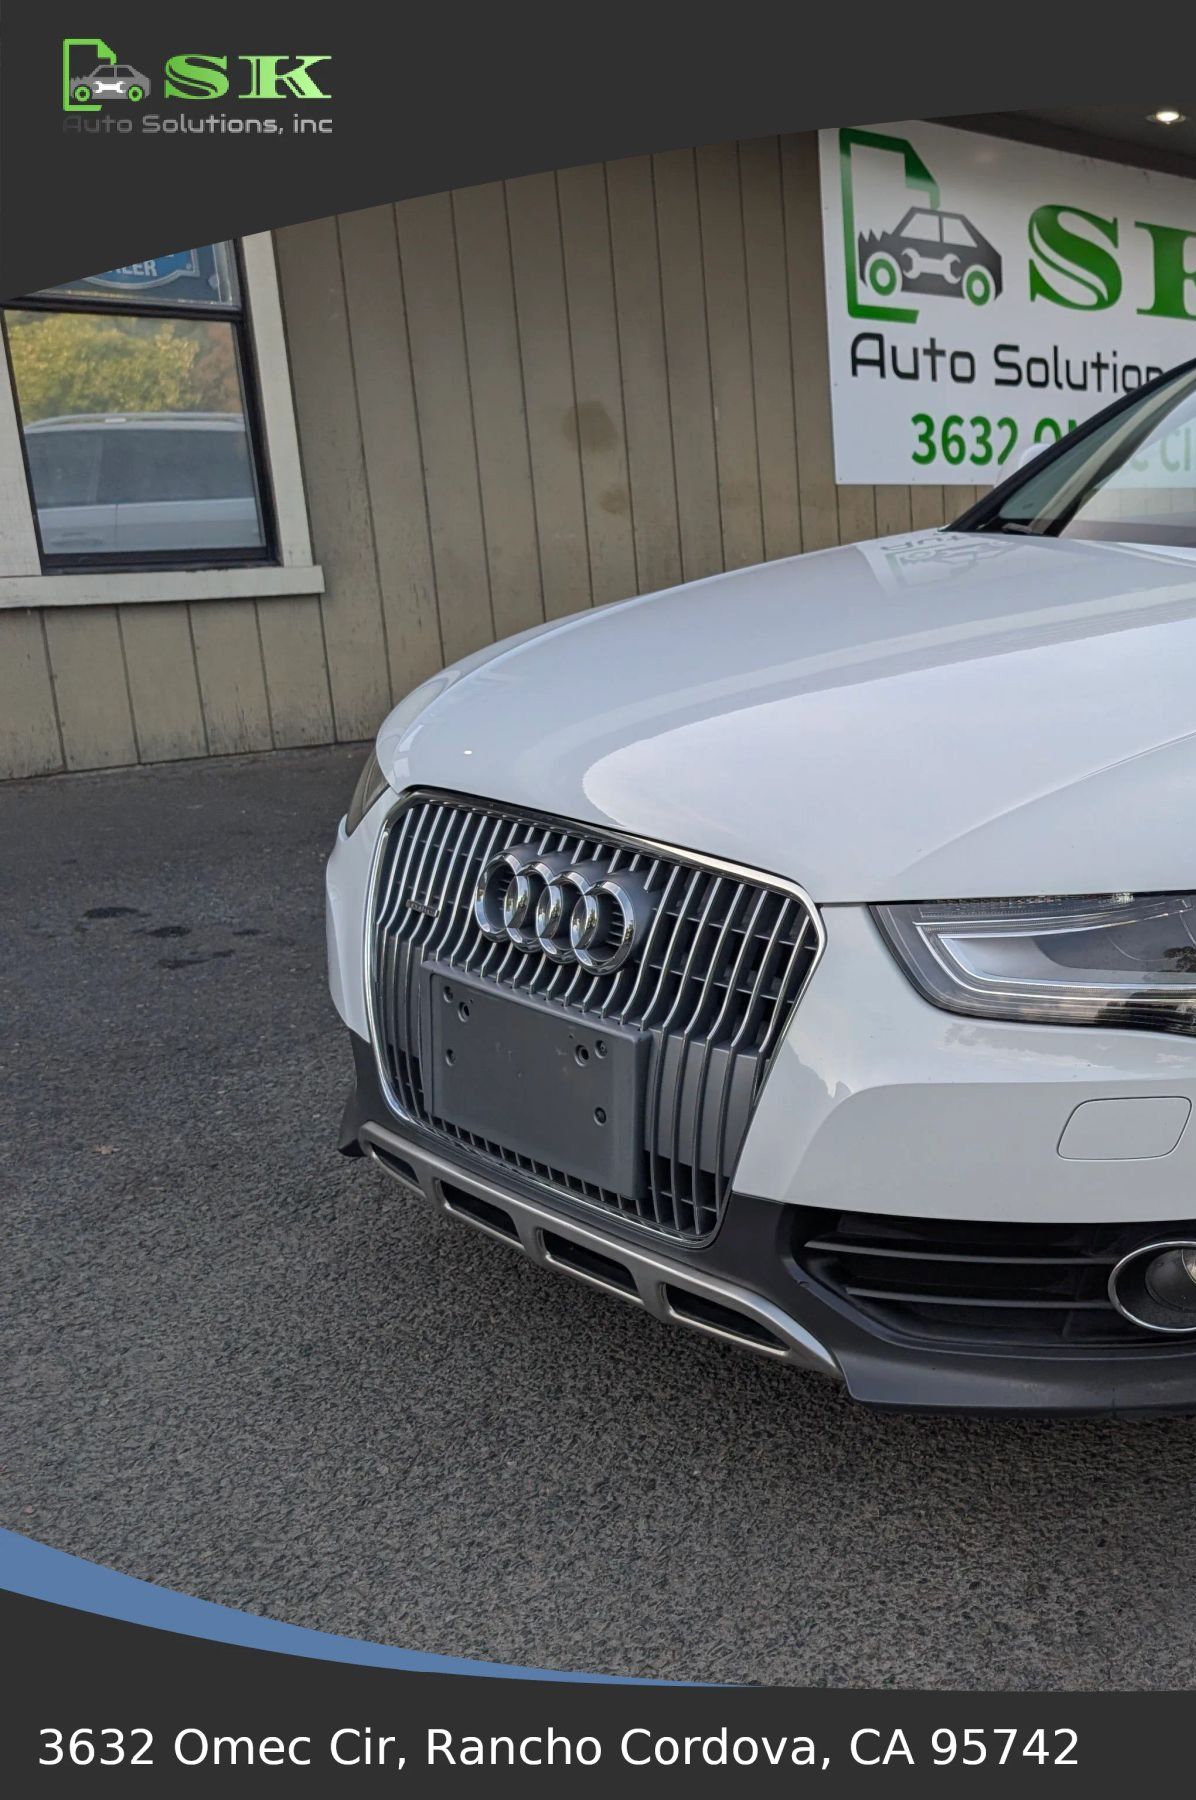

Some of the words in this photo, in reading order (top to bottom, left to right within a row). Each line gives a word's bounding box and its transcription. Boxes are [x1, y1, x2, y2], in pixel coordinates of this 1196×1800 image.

[850, 331, 976, 384] Auto
[994, 343, 1164, 394] Solution
[911, 413, 1018, 465] 3632
